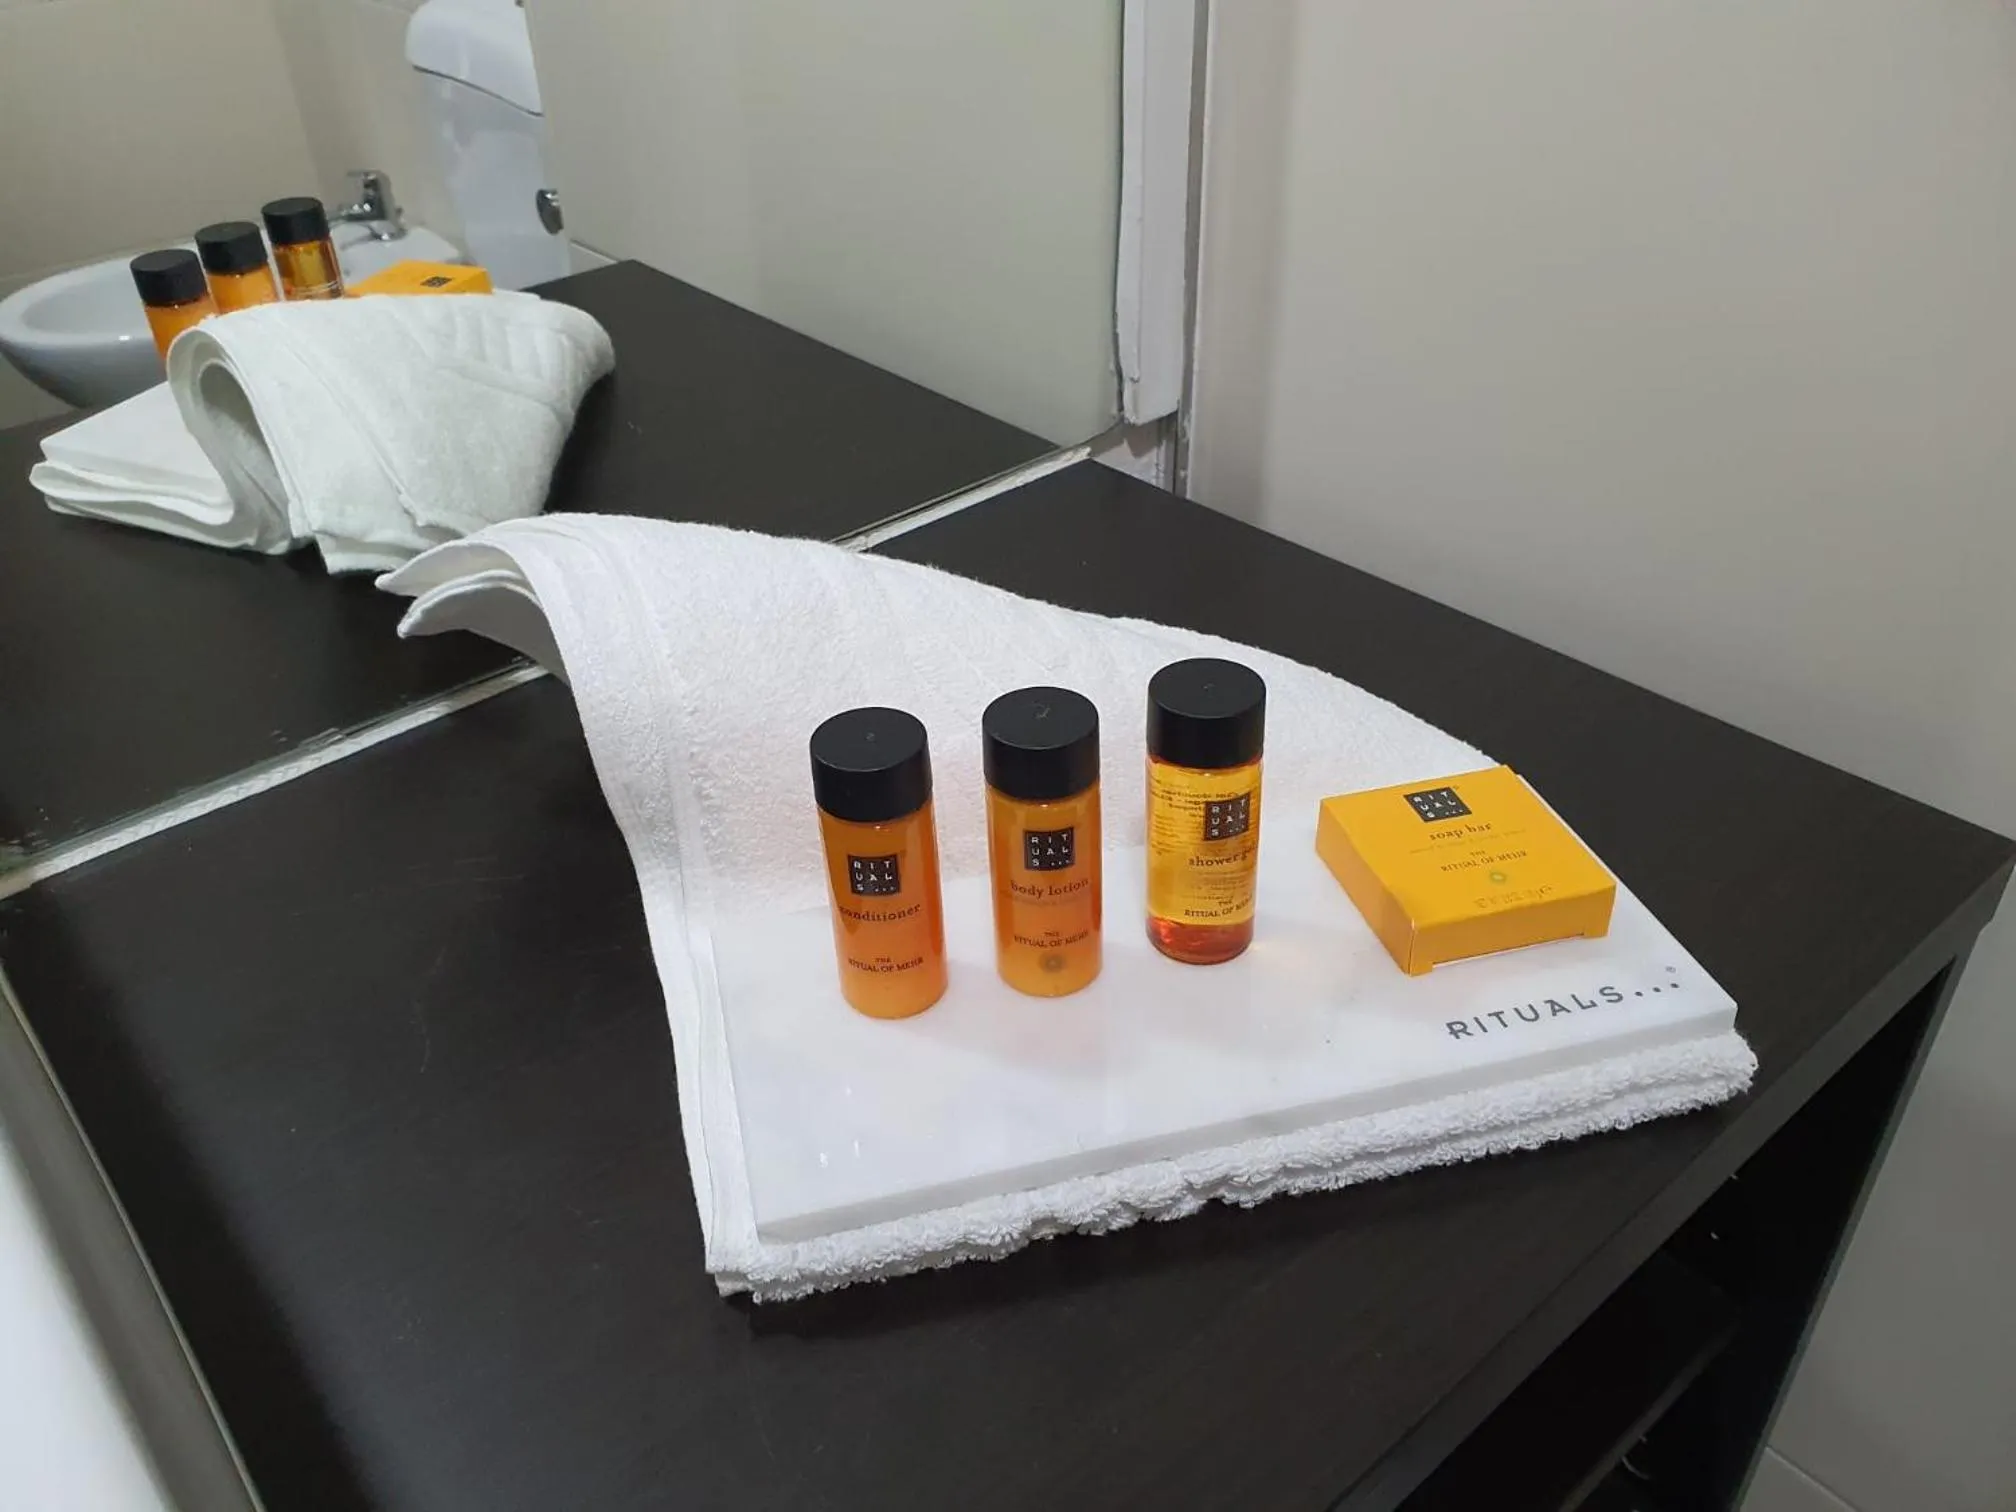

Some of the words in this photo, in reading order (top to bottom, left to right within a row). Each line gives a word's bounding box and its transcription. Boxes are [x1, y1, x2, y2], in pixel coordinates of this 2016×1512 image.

[1429, 828, 1463, 841] soap
[1464, 823, 1492, 835] bar
[1188, 853, 1240, 867] shower
[1440, 859, 1481, 872] RITUAL
[1481, 855, 1496, 865] OF
[1010, 880, 1044, 899] body
[1048, 879, 1089, 896] lotion
[1184, 909, 1221, 918] RITUAL
